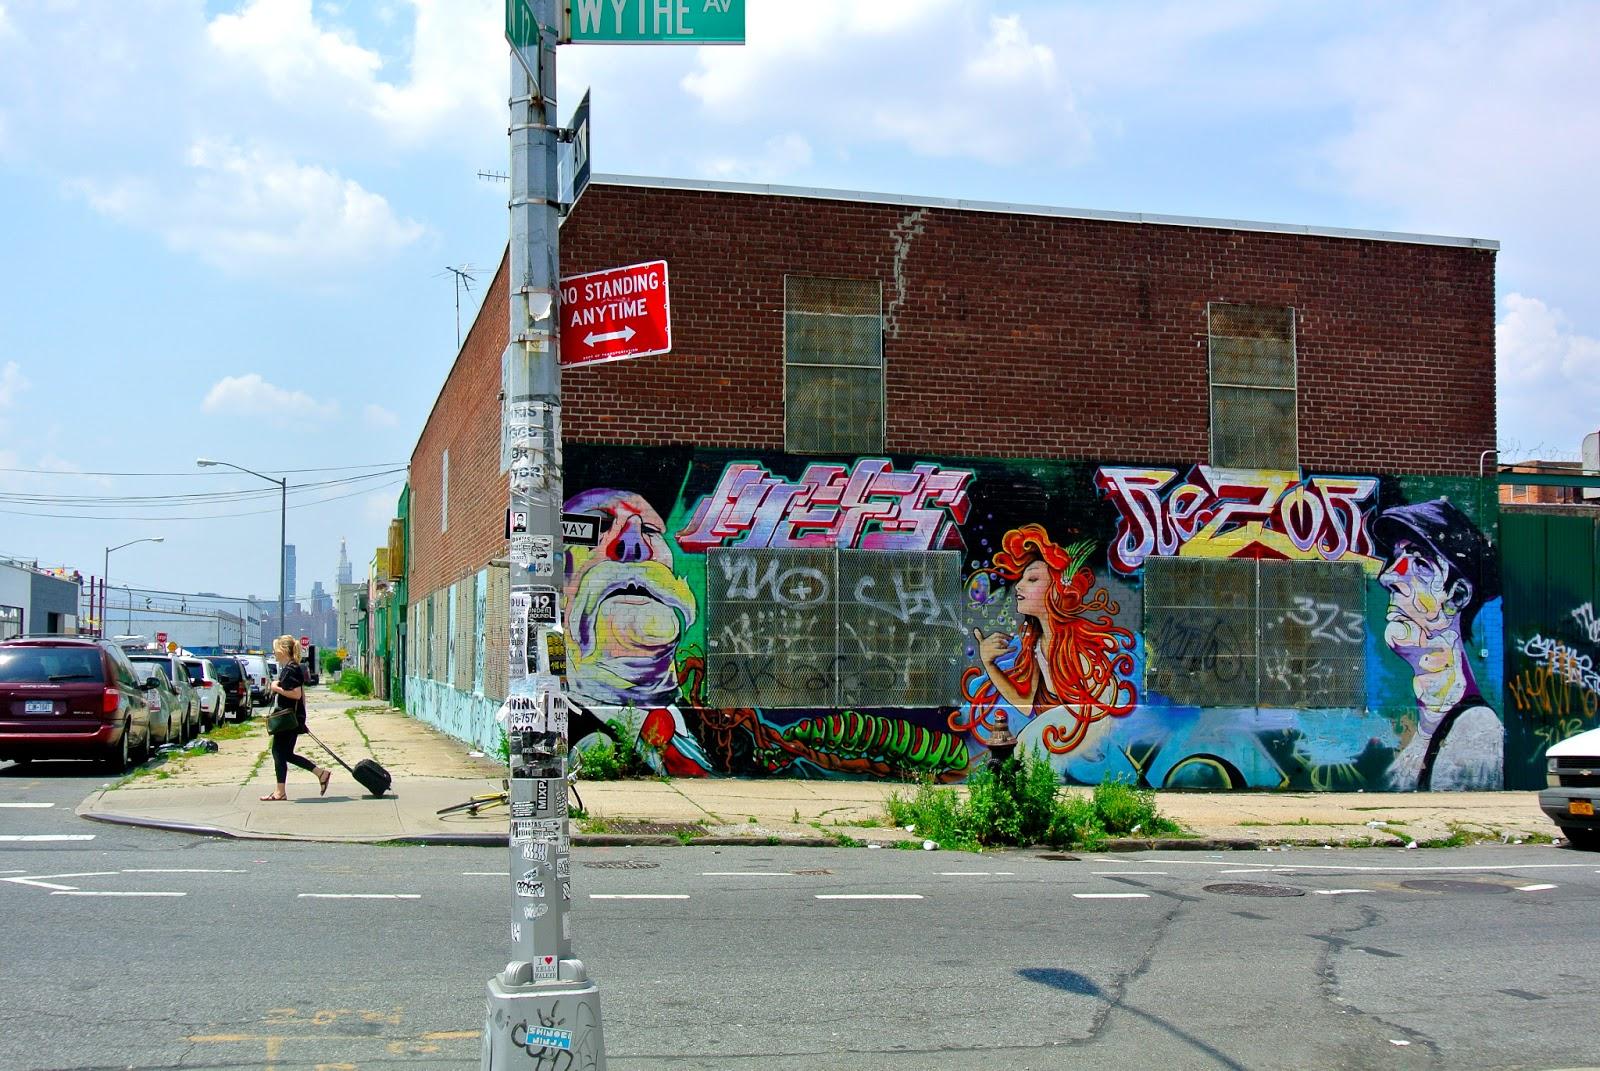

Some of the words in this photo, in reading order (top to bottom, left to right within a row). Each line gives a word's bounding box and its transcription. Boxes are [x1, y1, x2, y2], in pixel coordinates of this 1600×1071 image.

[577, 0, 695, 35] WYTHE
[560, 287, 578, 306] NO
[585, 271, 659, 302] STANDING
[570, 298, 648, 328] ANYTIME
[537, 779, 548, 810] MIXP
